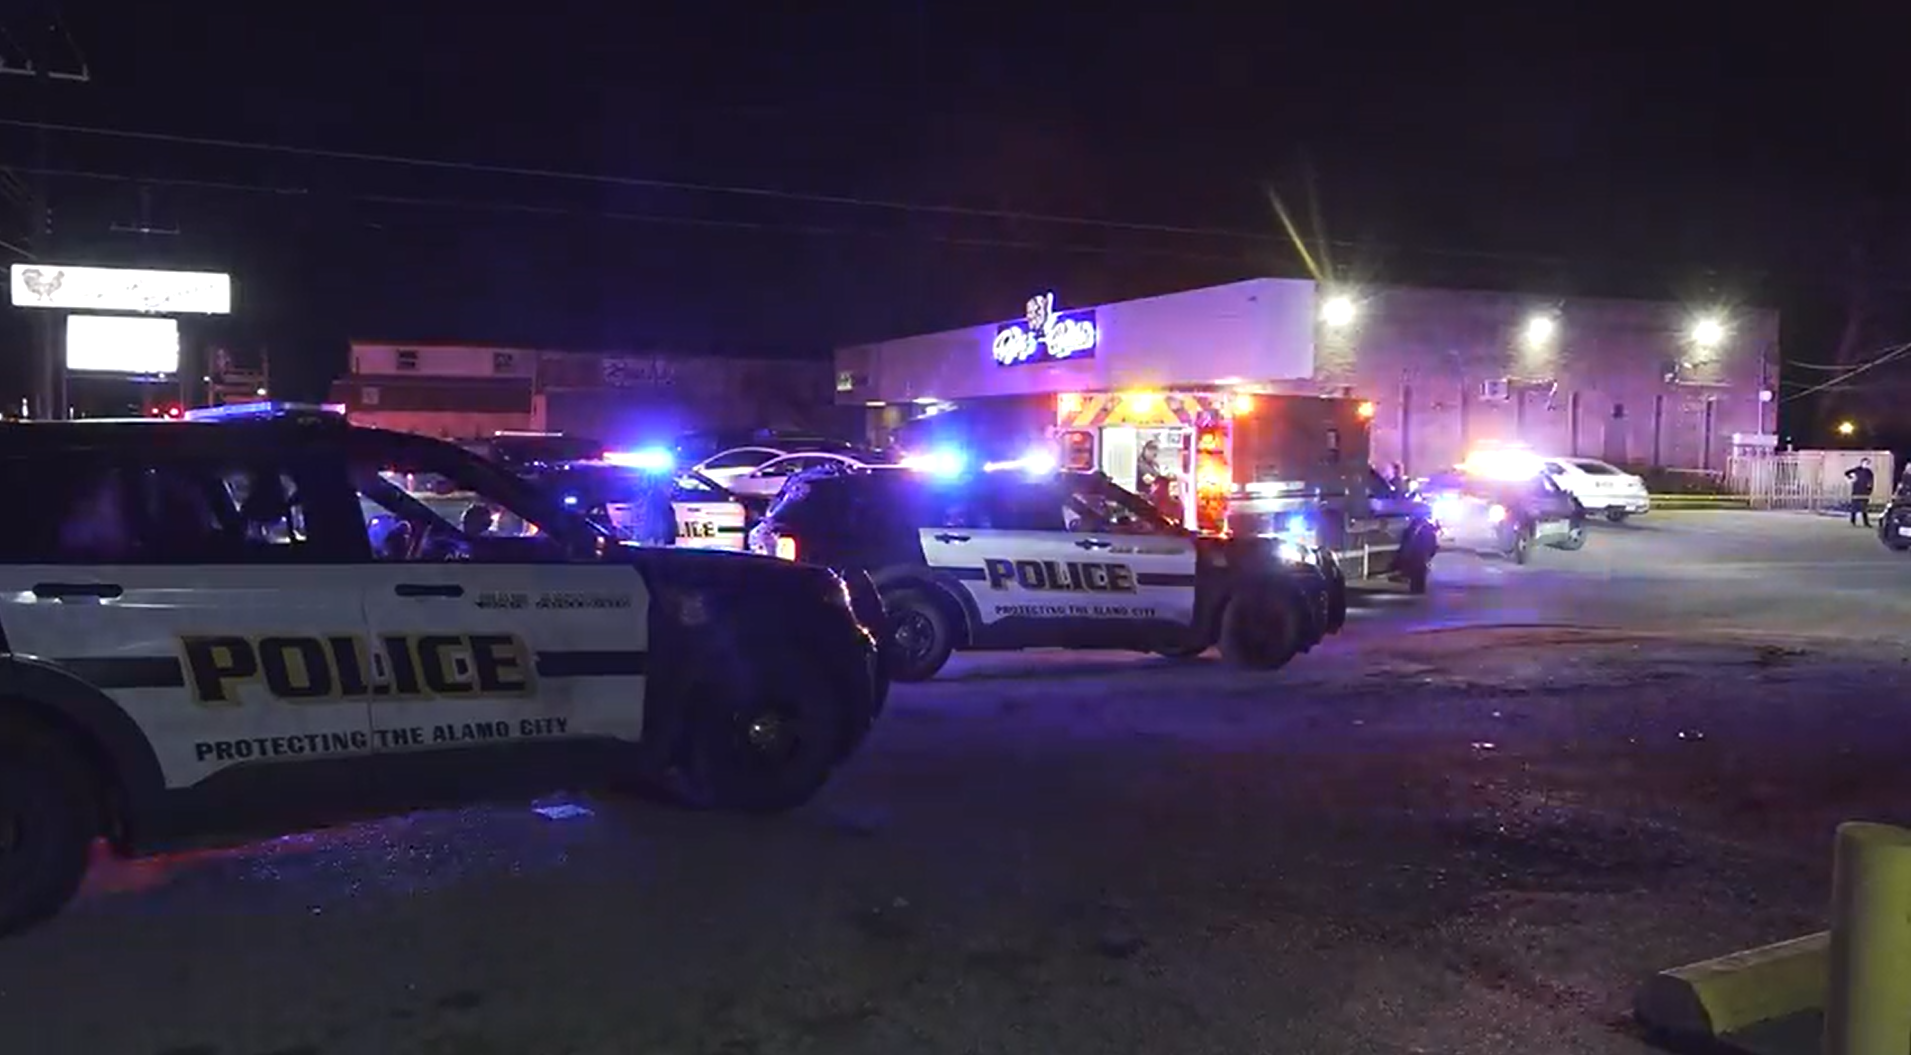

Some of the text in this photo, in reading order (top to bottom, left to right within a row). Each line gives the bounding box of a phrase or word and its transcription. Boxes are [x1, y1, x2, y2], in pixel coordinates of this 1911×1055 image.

[984, 558, 1138, 594] POLICE
[177, 632, 535, 704] POLICE
[195, 717, 569, 762] PROTECTING THE ALAMO CITY
